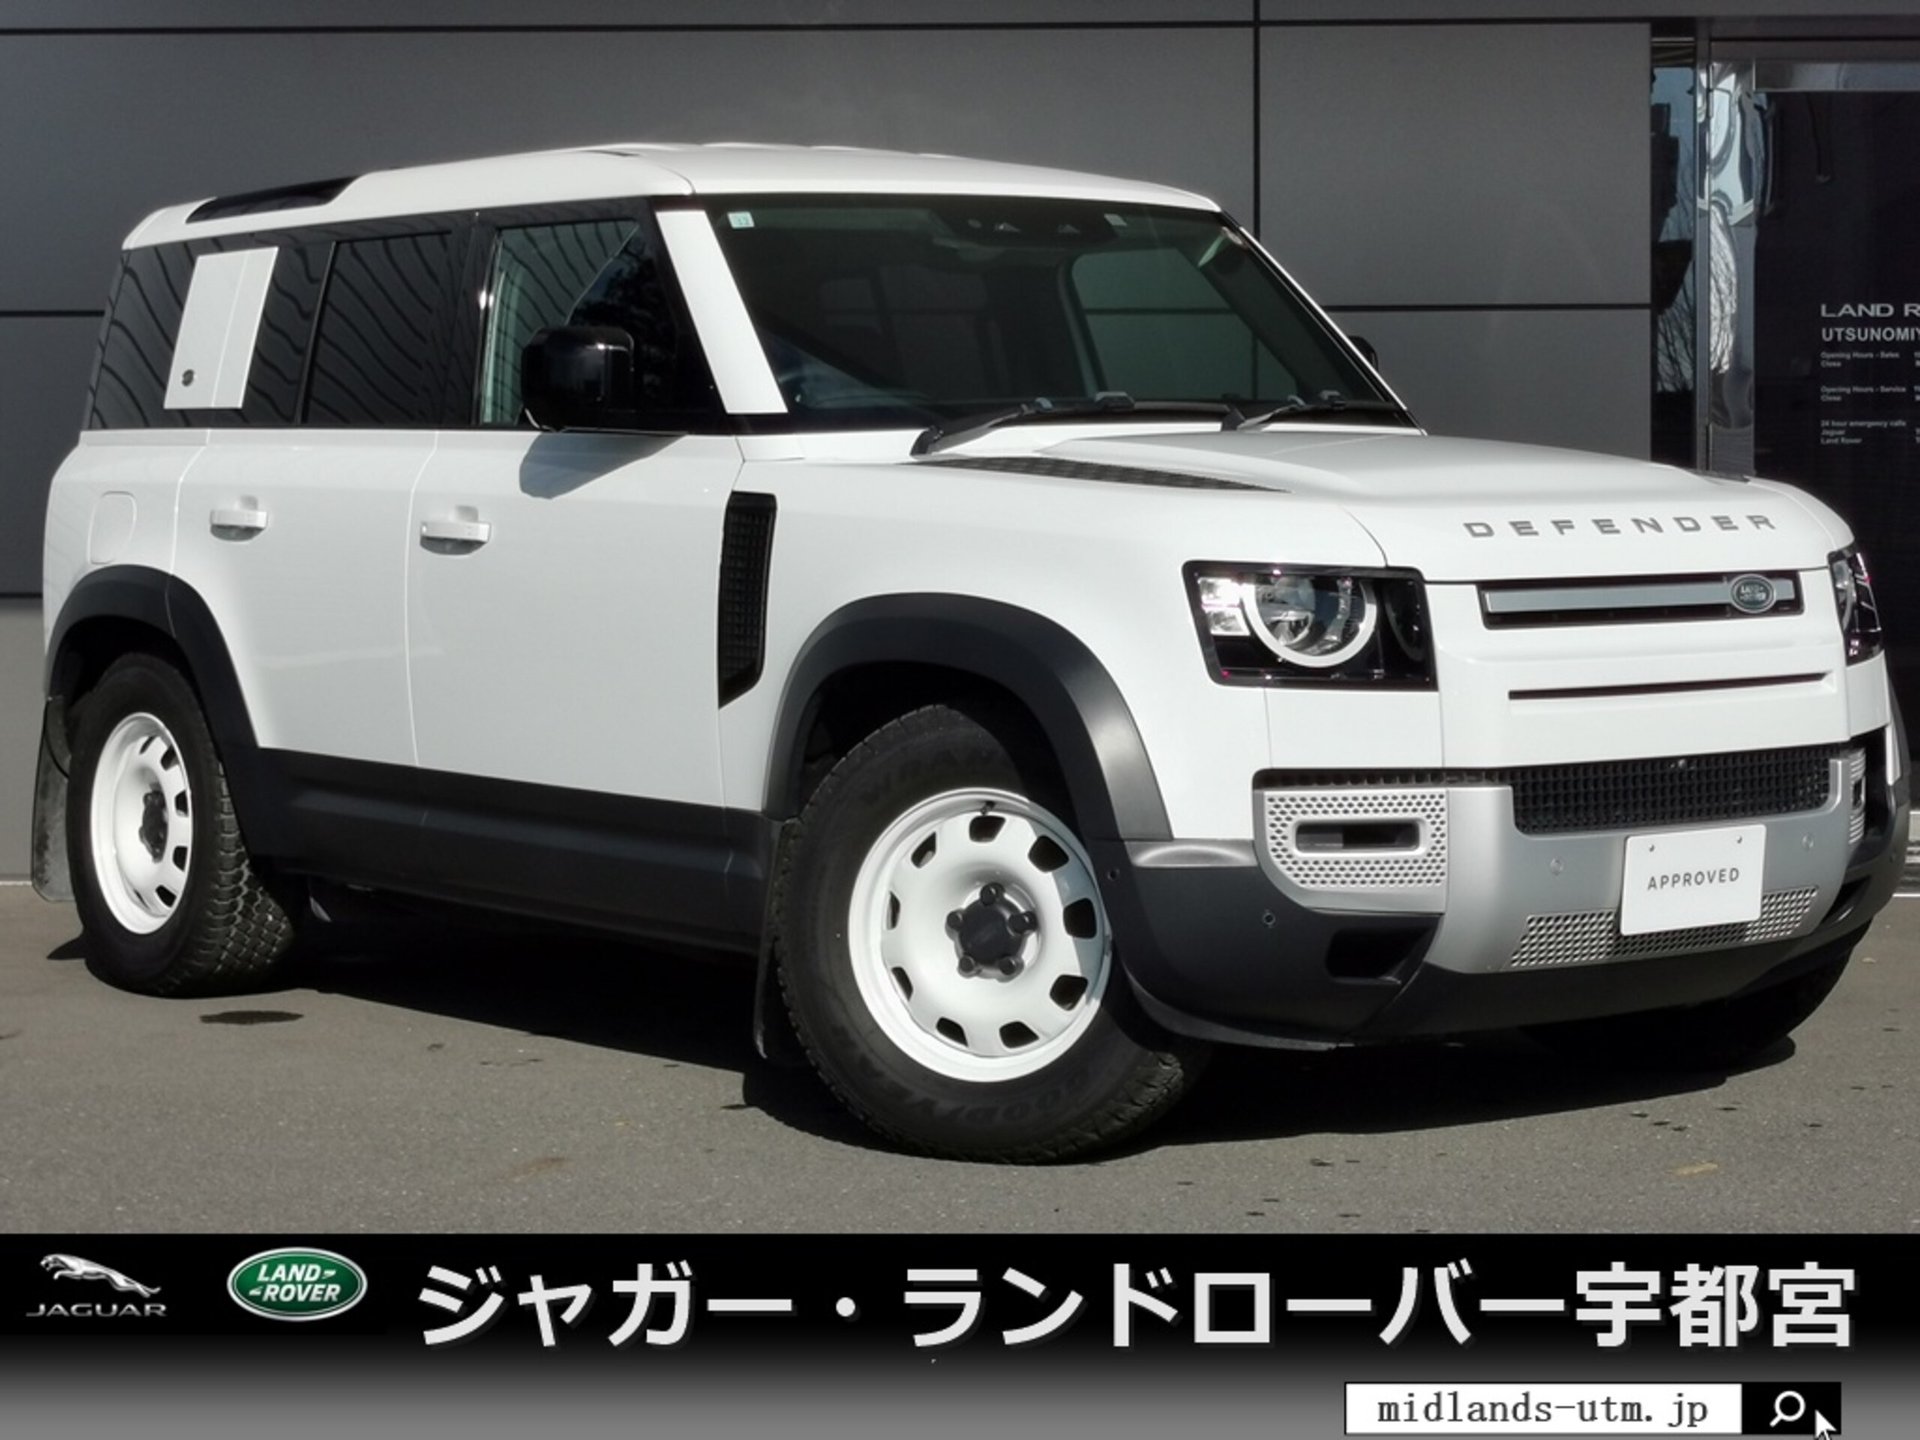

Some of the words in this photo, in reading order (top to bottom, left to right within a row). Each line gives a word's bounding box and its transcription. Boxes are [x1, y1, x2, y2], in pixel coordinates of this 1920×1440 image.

[1820, 303, 1894, 318] LAND
[1463, 514, 1776, 538] DEFENDER
[1647, 867, 1740, 891] APPROVED
